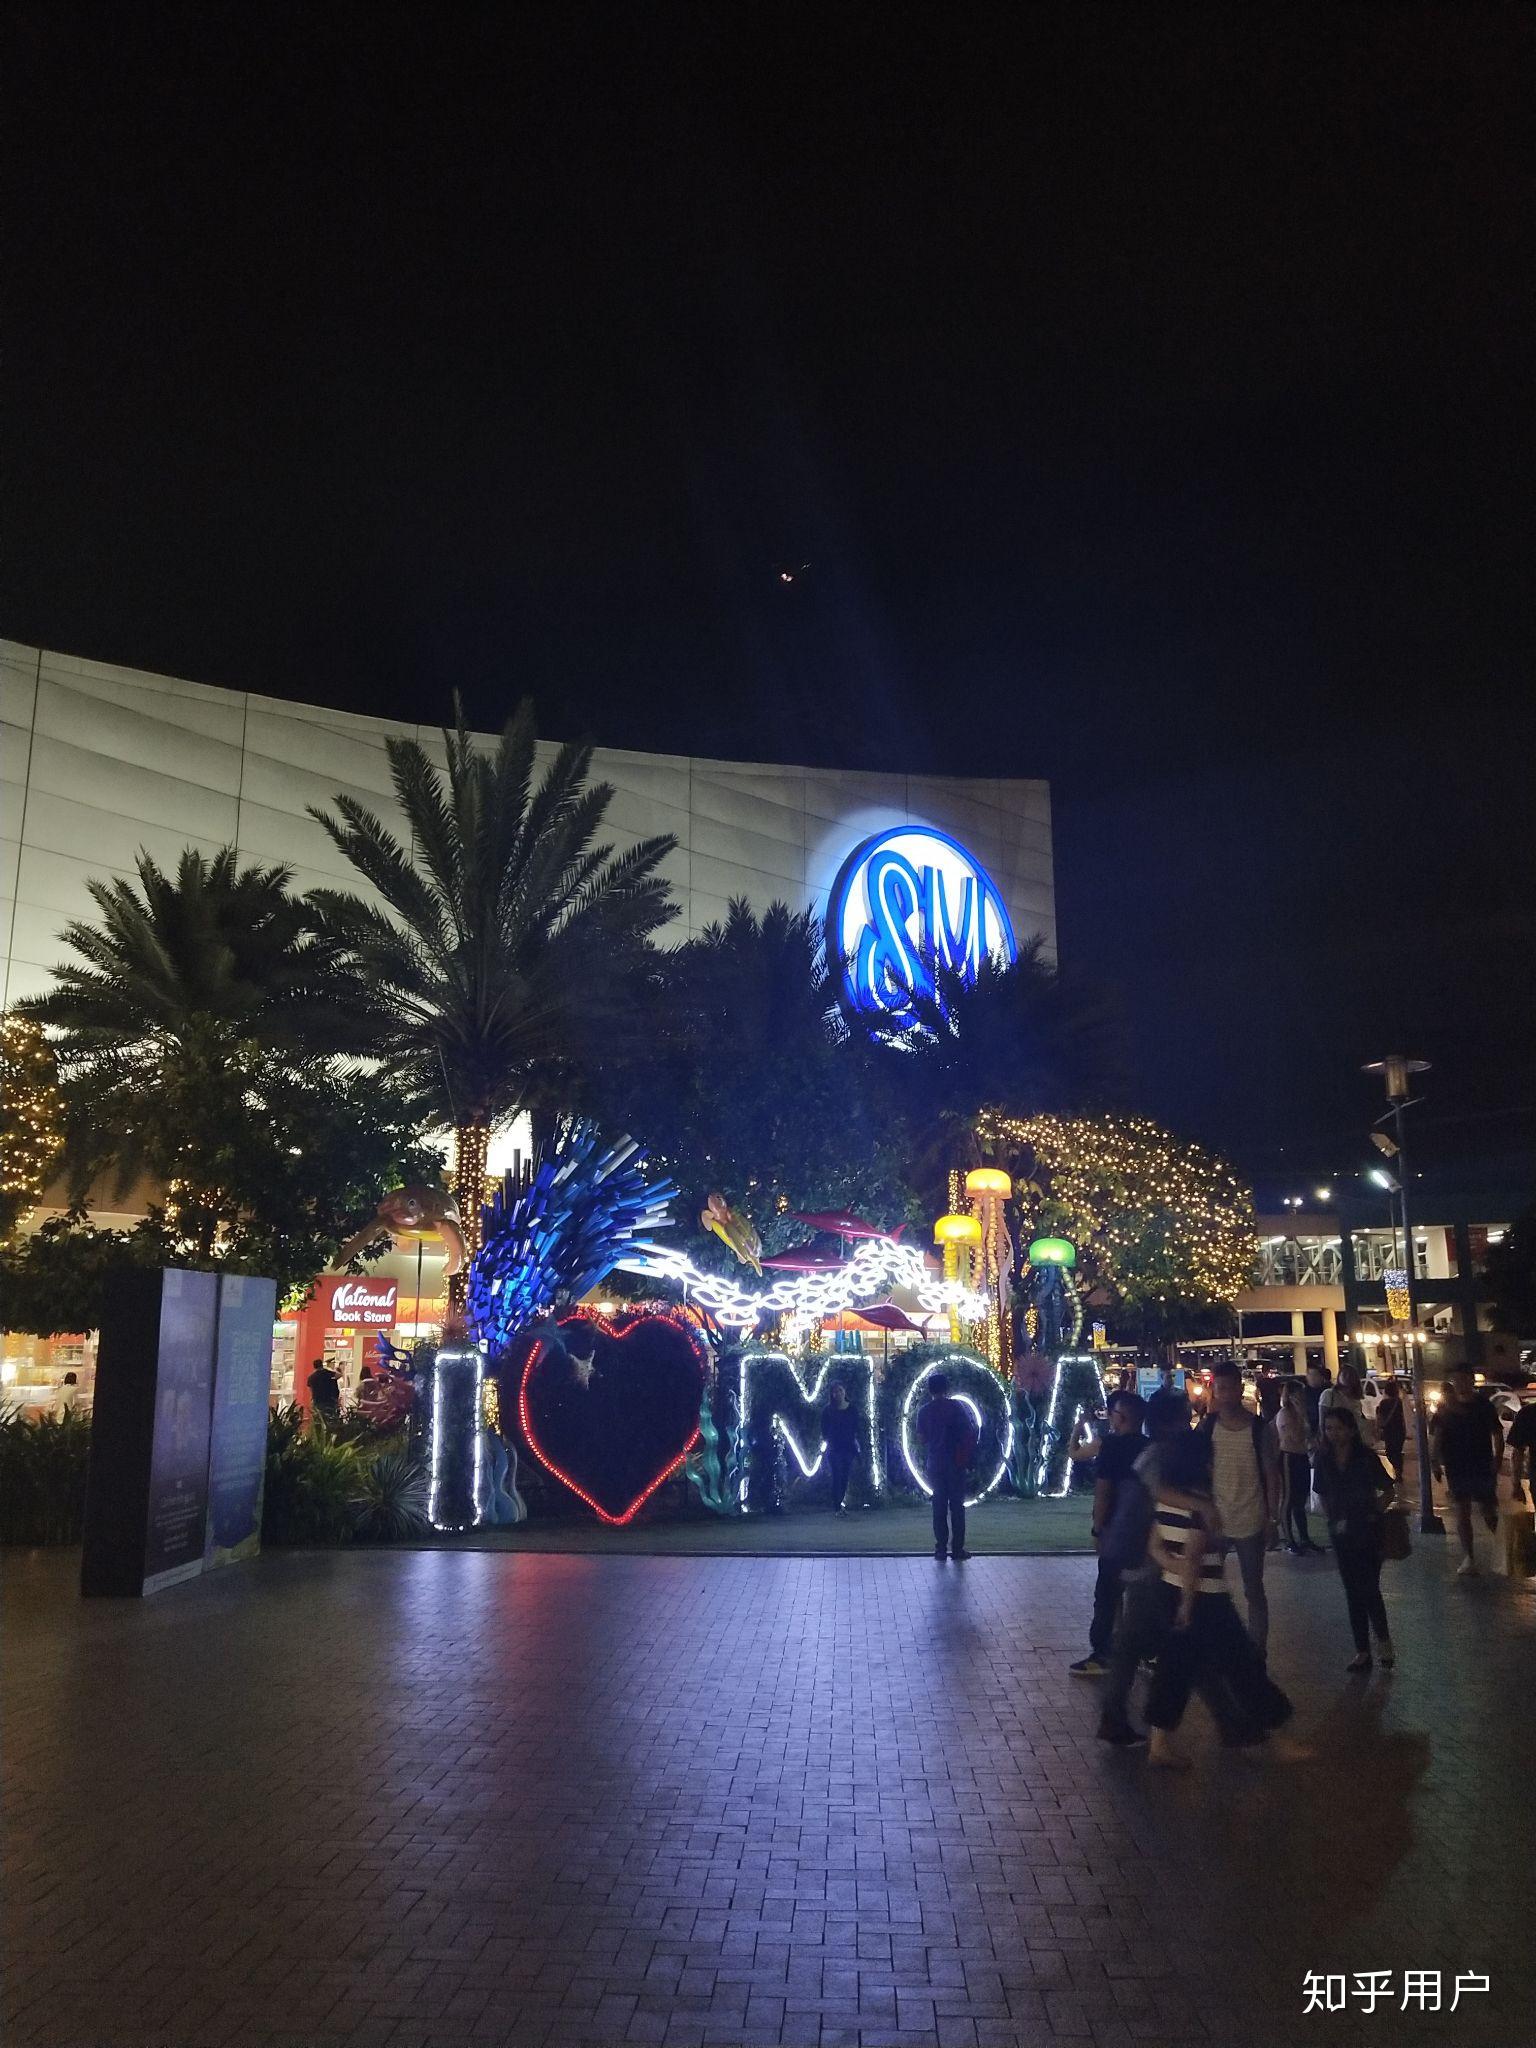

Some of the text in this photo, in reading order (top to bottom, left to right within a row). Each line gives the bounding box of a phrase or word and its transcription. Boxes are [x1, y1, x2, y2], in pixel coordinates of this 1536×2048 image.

[855, 849, 986, 1028] SM
[331, 1283, 396, 1310] National
[333, 1310, 392, 1323] Book Store
[738, 1353, 1109, 1513] MOA
